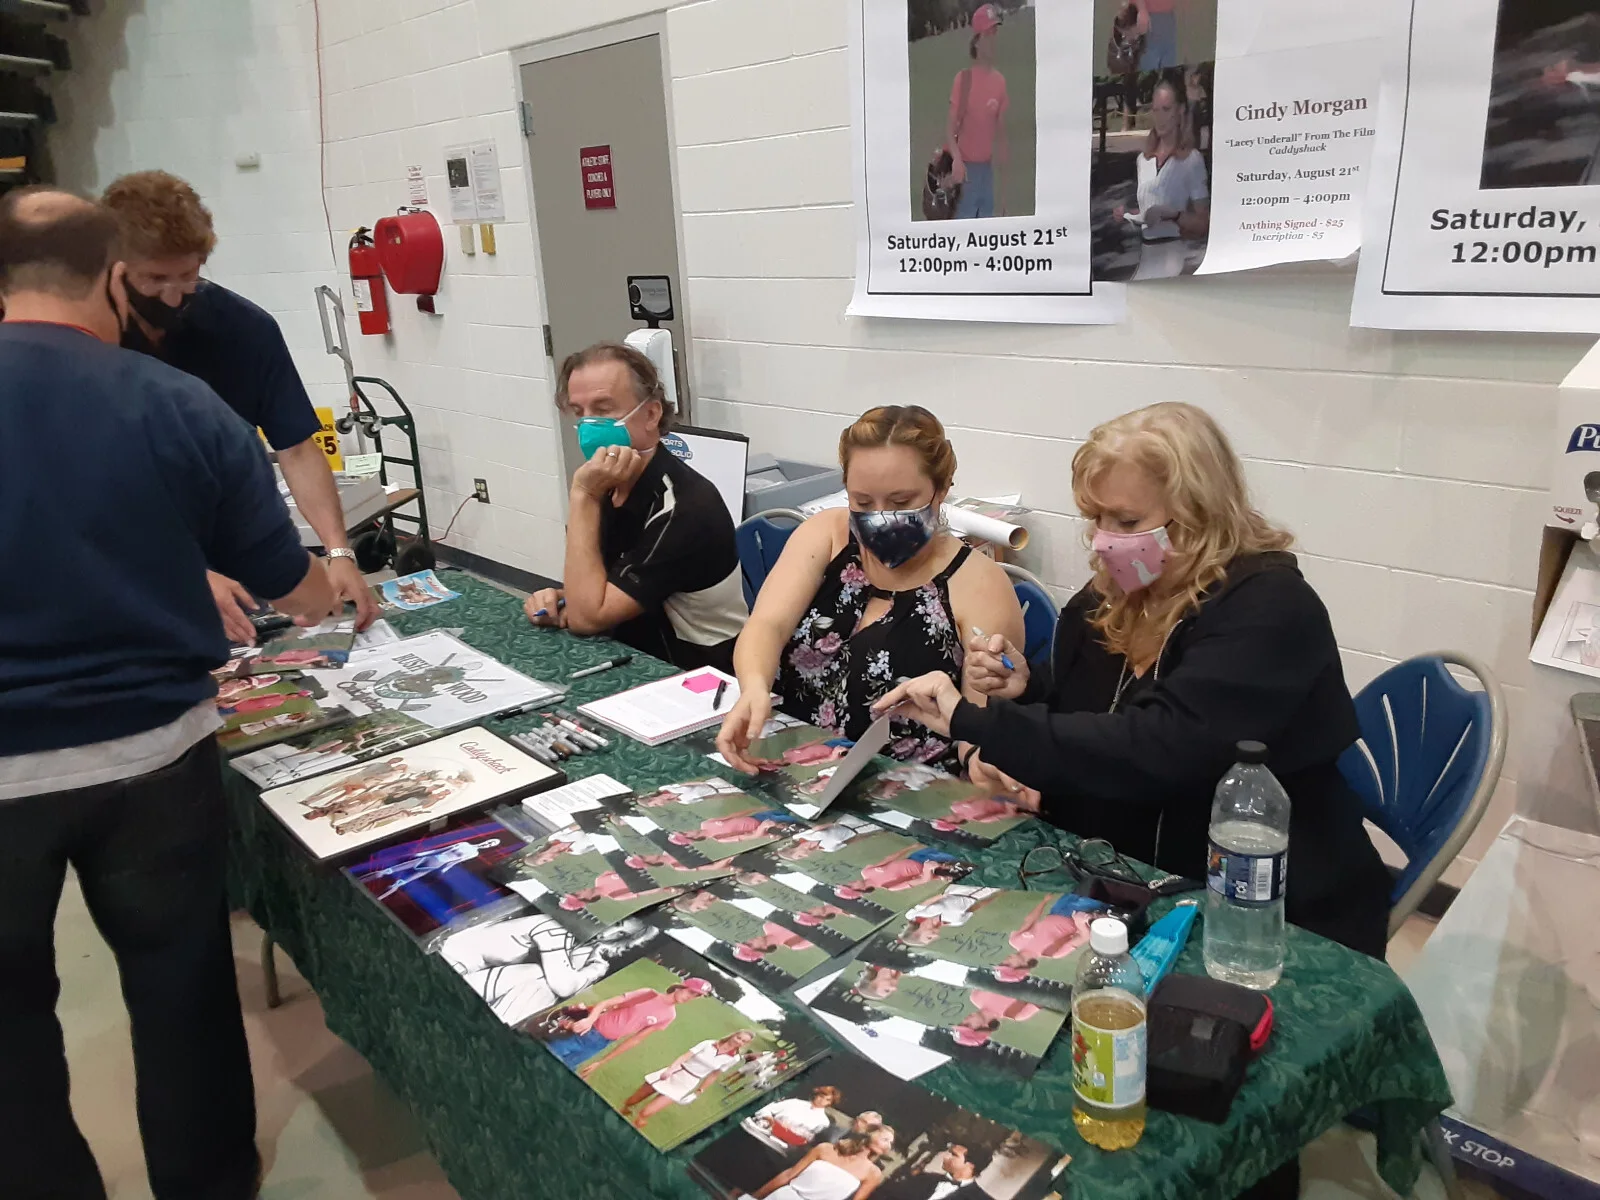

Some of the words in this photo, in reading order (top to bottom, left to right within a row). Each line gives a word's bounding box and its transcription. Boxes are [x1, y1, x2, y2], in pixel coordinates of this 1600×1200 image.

[1235, 102, 1288, 121] Cindy
[1293, 97, 1368, 117] Morgan
[1304, 132, 1330, 141] From
[1332, 129, 1351, 139] The
[1268, 143, 1327, 155] Caddyshack
[1236, 170, 1292, 183] Saturday,
[1294, 167, 1336, 180] August
[1338, 165, 1360, 177] 21st
[1240, 195, 1290, 207] 12:00pm
[1303, 193, 1351, 205] 4:00pm
[1239, 220, 1282, 232] Anything
[1283, 218, 1318, 230] Signed
[1325, 218, 1345, 228] $25
[1430, 205, 1587, 234] Saturday,
[887, 233, 961, 252] Saturday,
[966, 230, 1027, 251] August
[1033, 226, 1068, 246] 21st
[1251, 232, 1304, 242] Inscription
[1311, 231, 1325, 240] $5
[1451, 240, 1597, 269] 12:00pm
[899, 257, 968, 276] 12:00pm
[985, 255, 1053, 275] 4:00pm
[671, 449, 693, 460] SOLID
[1553, 505, 1583, 515] SQUEEZE
[392, 652, 433, 672] BUSH
[443, 682, 488, 703] WOOD
[459, 741, 518, 775] Caddyshack
[1460, 1140, 1516, 1167] STOP
